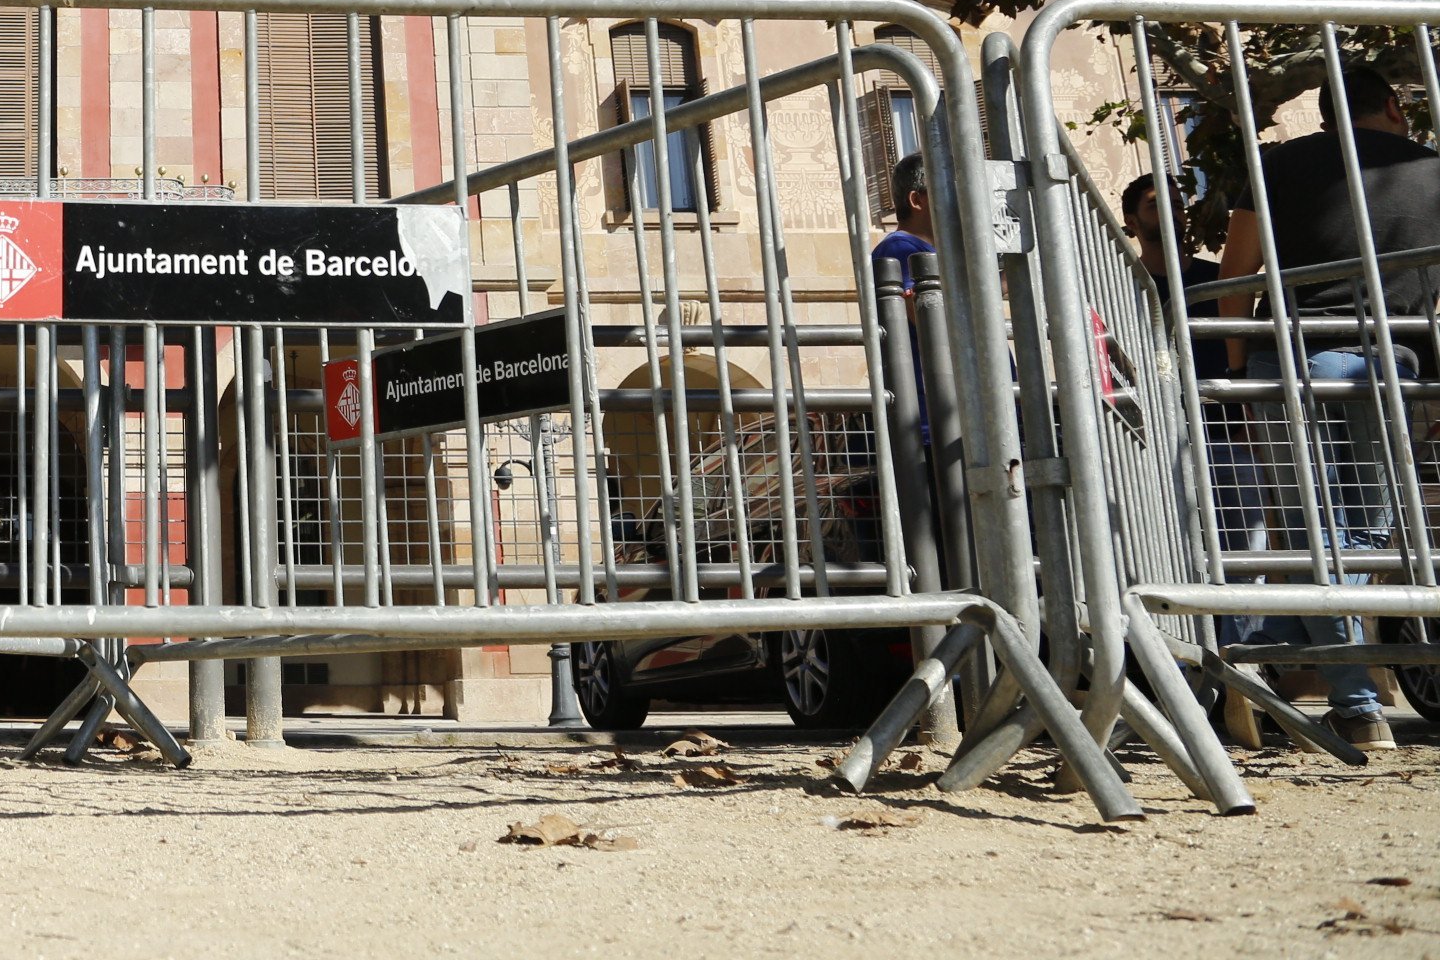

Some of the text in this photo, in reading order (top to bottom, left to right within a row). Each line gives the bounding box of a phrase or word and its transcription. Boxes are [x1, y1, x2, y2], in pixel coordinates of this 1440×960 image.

[75, 245, 422, 279] Ajuntament de Barcelo
[386, 373, 465, 403] Ajuntamen
[493, 352, 570, 381] Barcelona
